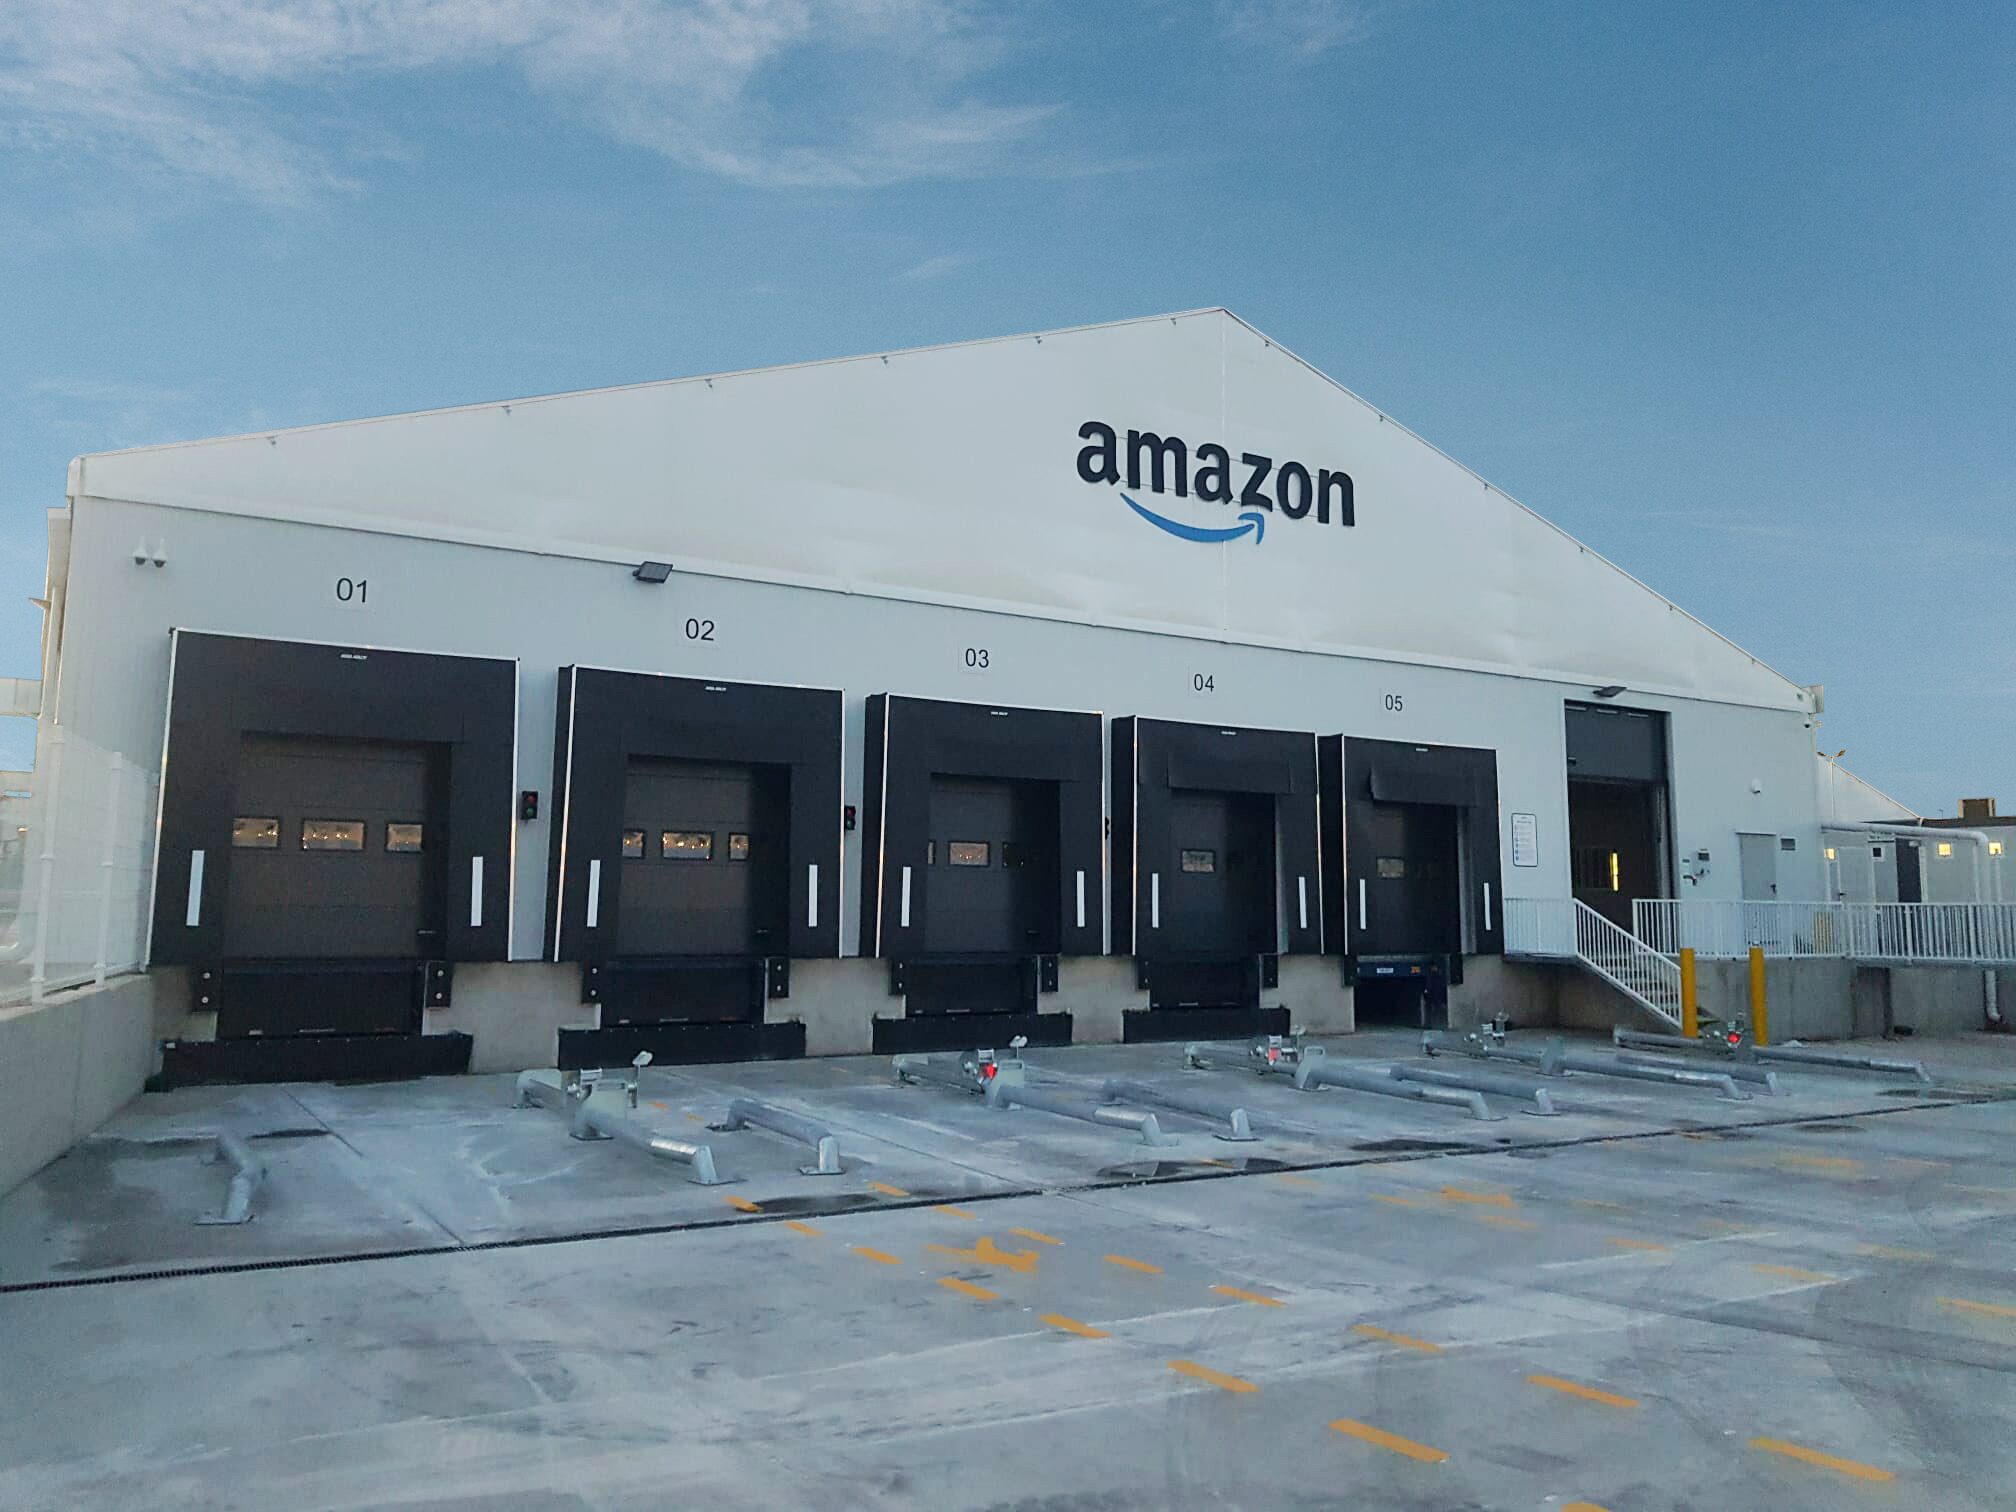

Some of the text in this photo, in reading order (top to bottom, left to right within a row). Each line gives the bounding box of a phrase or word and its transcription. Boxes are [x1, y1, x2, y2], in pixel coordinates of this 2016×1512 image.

[1077, 422, 1354, 526] amazon
[336, 577, 367, 603] 01
[685, 618, 714, 642] 02
[965, 647, 990, 669] 03
[1193, 674, 1215, 693] 04
[1385, 694, 1403, 711] 05
